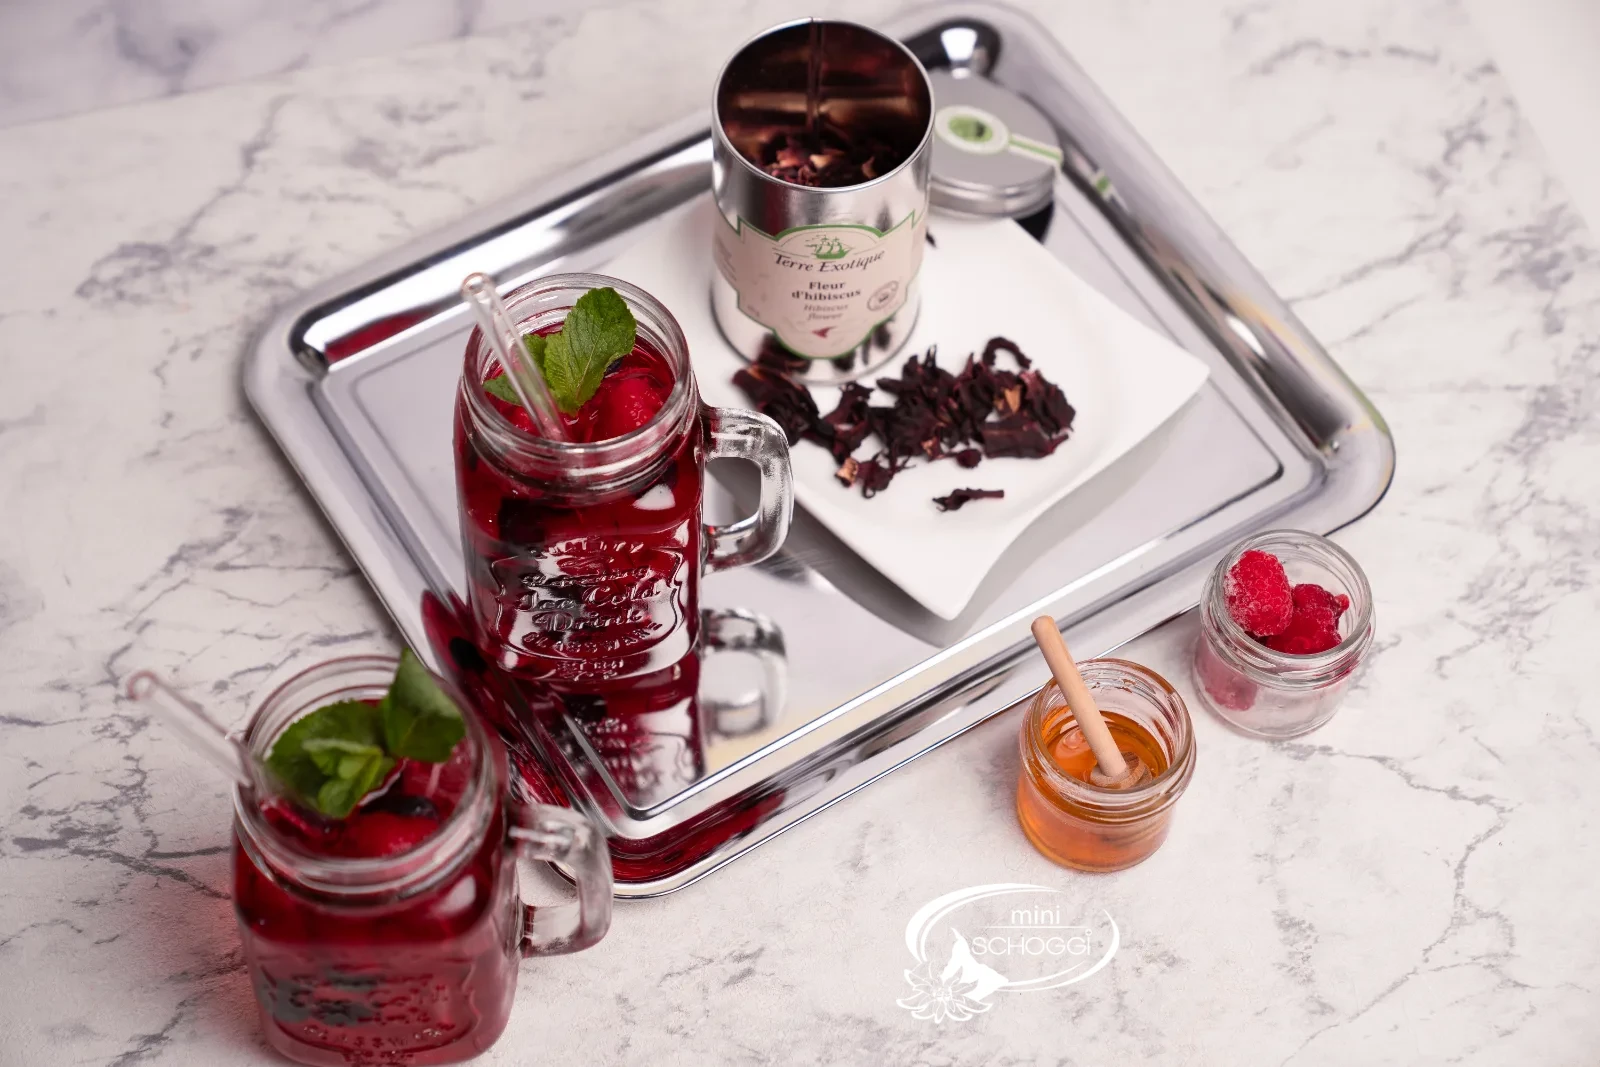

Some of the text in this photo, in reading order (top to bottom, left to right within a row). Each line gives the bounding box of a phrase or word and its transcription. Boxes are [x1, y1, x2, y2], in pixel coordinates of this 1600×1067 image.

[773, 250, 885, 273] Terre Exotique
[791, 288, 862, 301] d'hibiscus
[808, 281, 847, 290] Fleur
[581, 579, 662, 608] Cold
[531, 607, 645, 632] Drink
